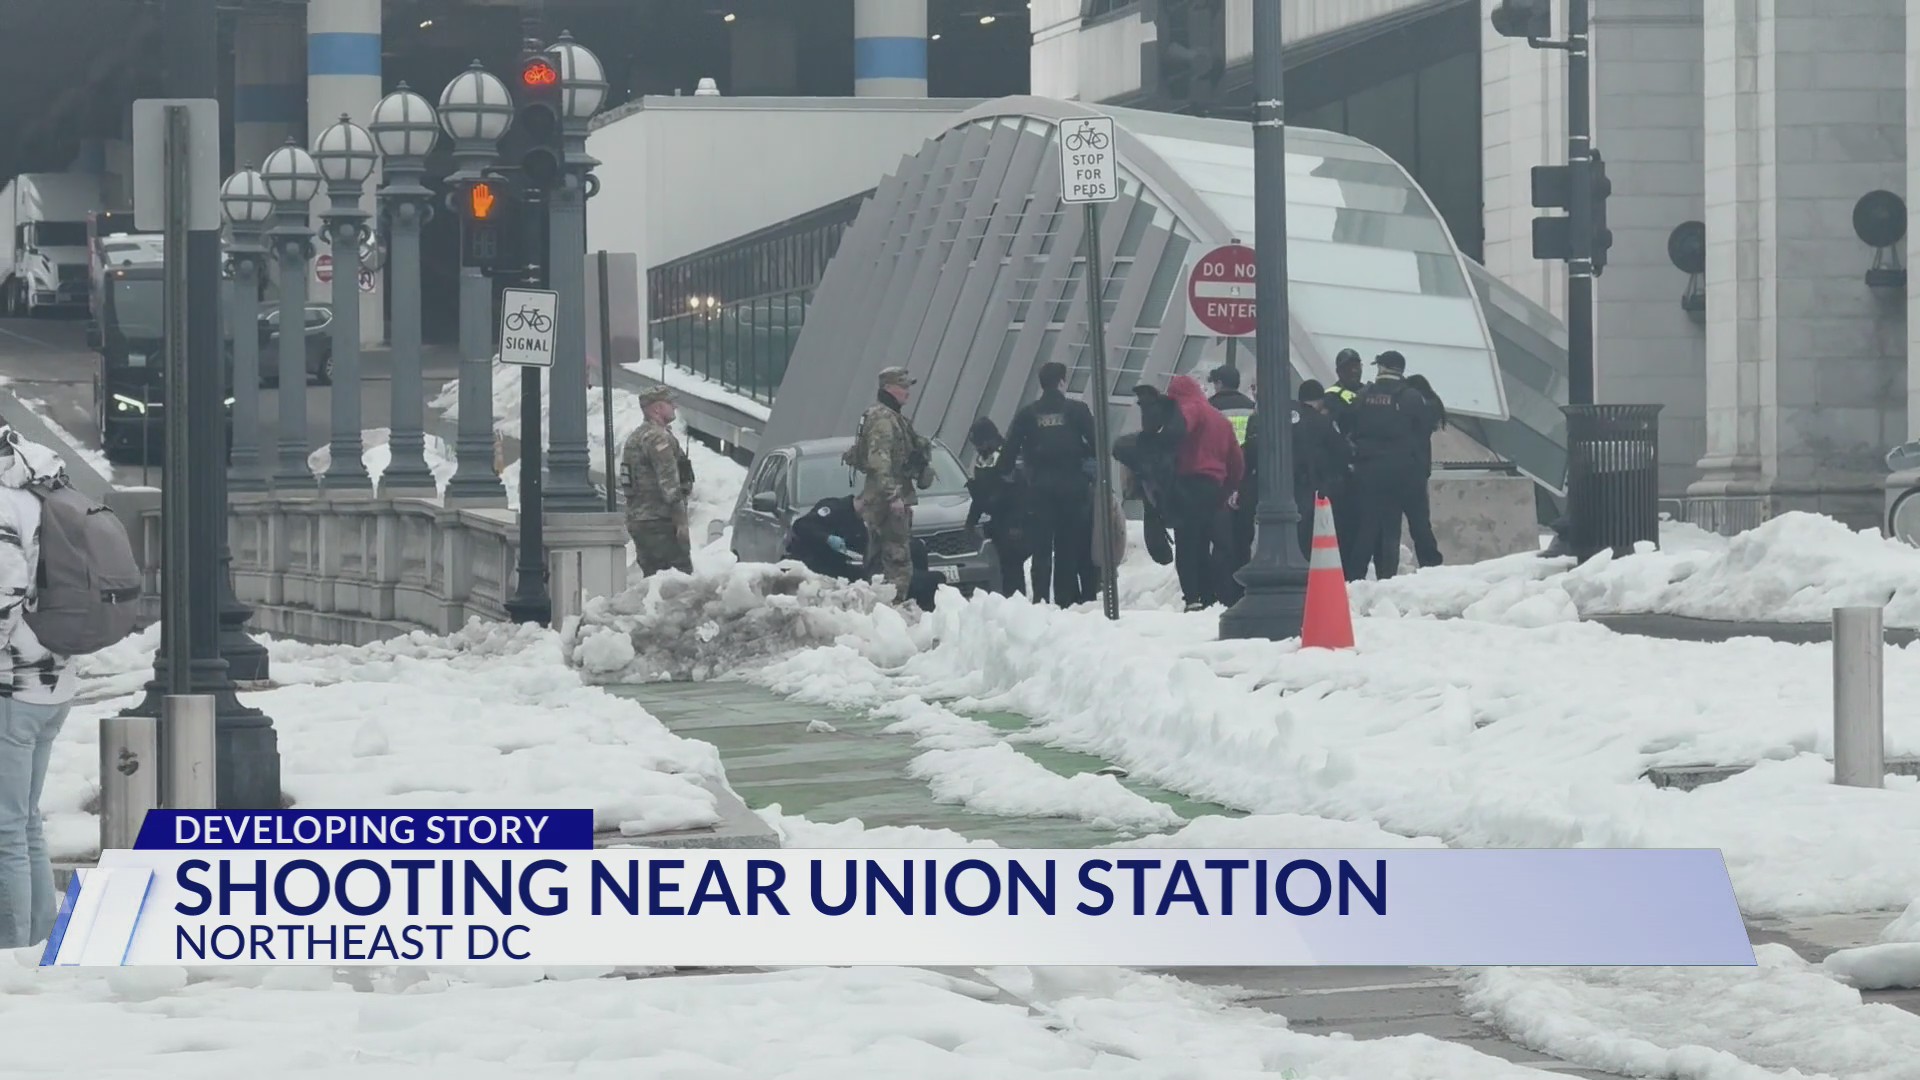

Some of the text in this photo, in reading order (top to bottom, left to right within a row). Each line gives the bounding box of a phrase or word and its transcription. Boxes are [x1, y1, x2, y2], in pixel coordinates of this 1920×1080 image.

[1072, 153, 1104, 166] STOP
[1076, 168, 1102, 180] FOR
[1073, 183, 1107, 196] PEDS
[1203, 262, 1256, 278] DO NO
[1207, 302, 1257, 318] ENTER
[505, 336, 549, 352] SIGNAL
